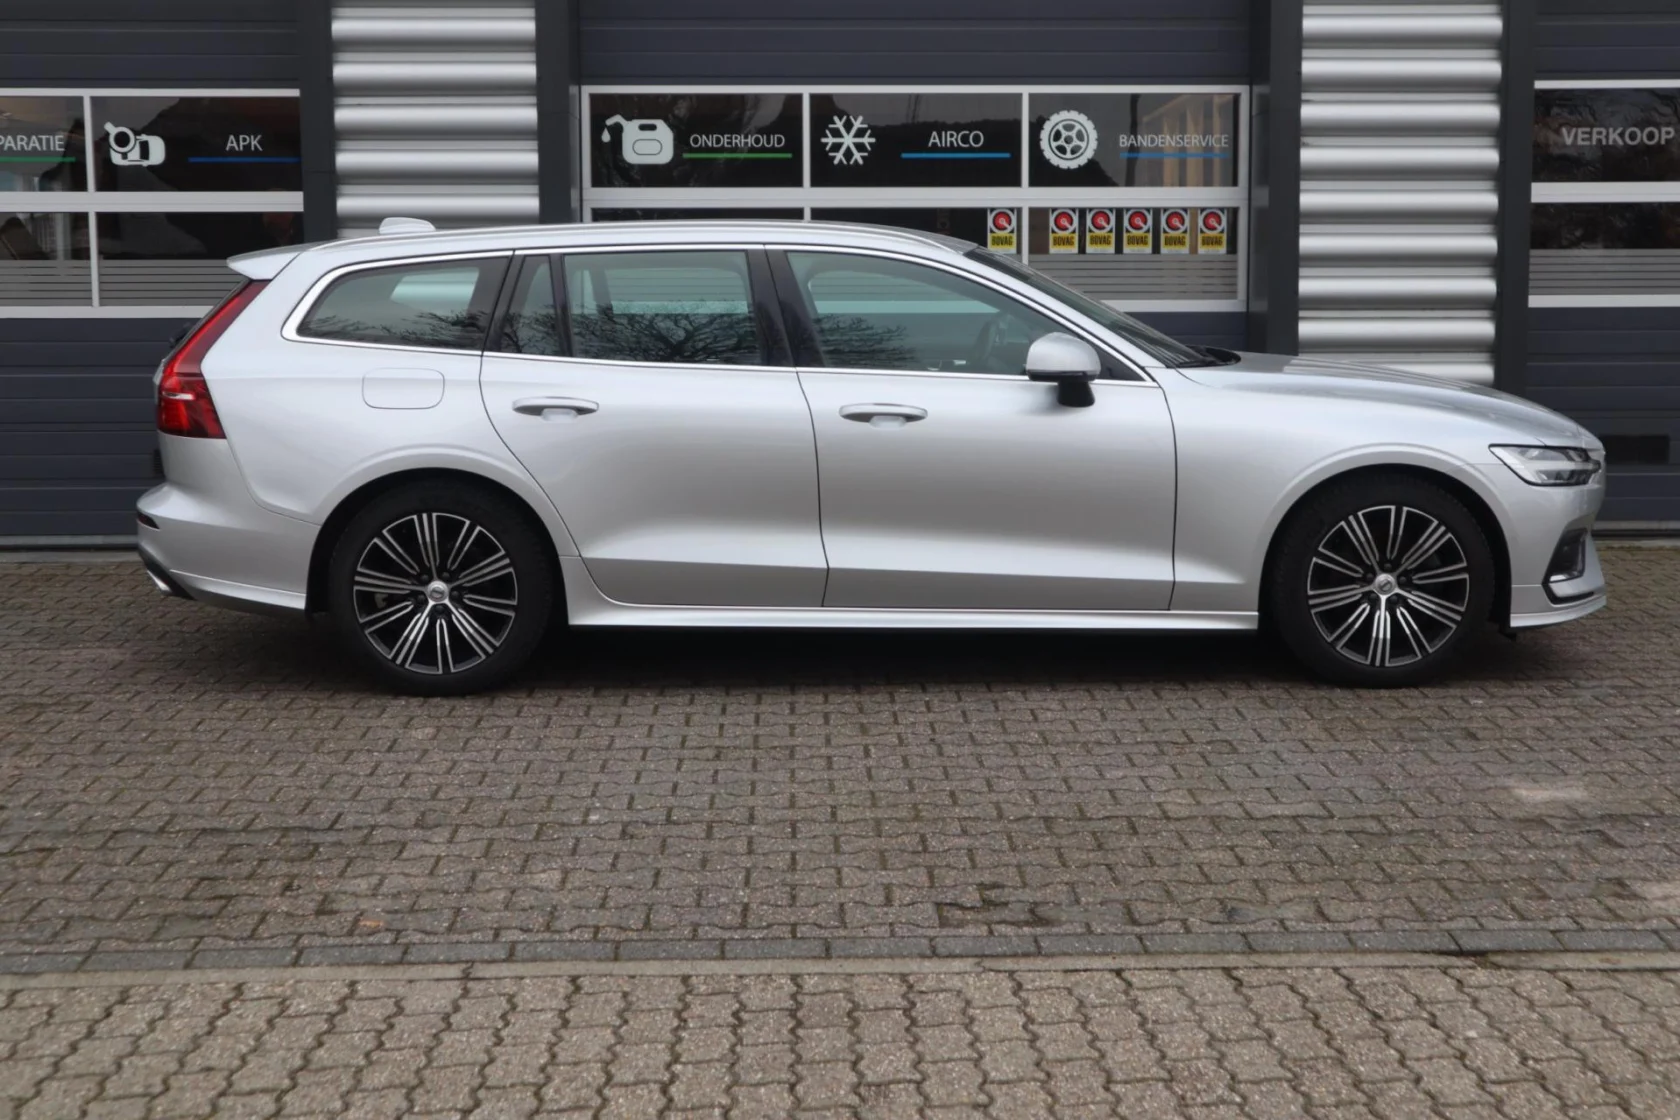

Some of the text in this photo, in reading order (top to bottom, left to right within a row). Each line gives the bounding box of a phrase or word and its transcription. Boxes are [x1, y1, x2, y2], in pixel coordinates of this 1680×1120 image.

[689, 134, 785, 148] ONDERHOUD
[928, 130, 984, 148] AIRCO
[1118, 133, 1229, 148] BANDENSERVICE
[1561, 126, 1675, 146] VERKOOP
[226, 134, 263, 151] APK
[991, 235, 1013, 246] BOVAG
[1052, 235, 1074, 246] BOVAG
[1089, 235, 1111, 246] BOVAG
[1127, 235, 1148, 246] BOVAG
[1164, 235, 1186, 246] BOVAG
[1201, 235, 1223, 246] BOVAG
